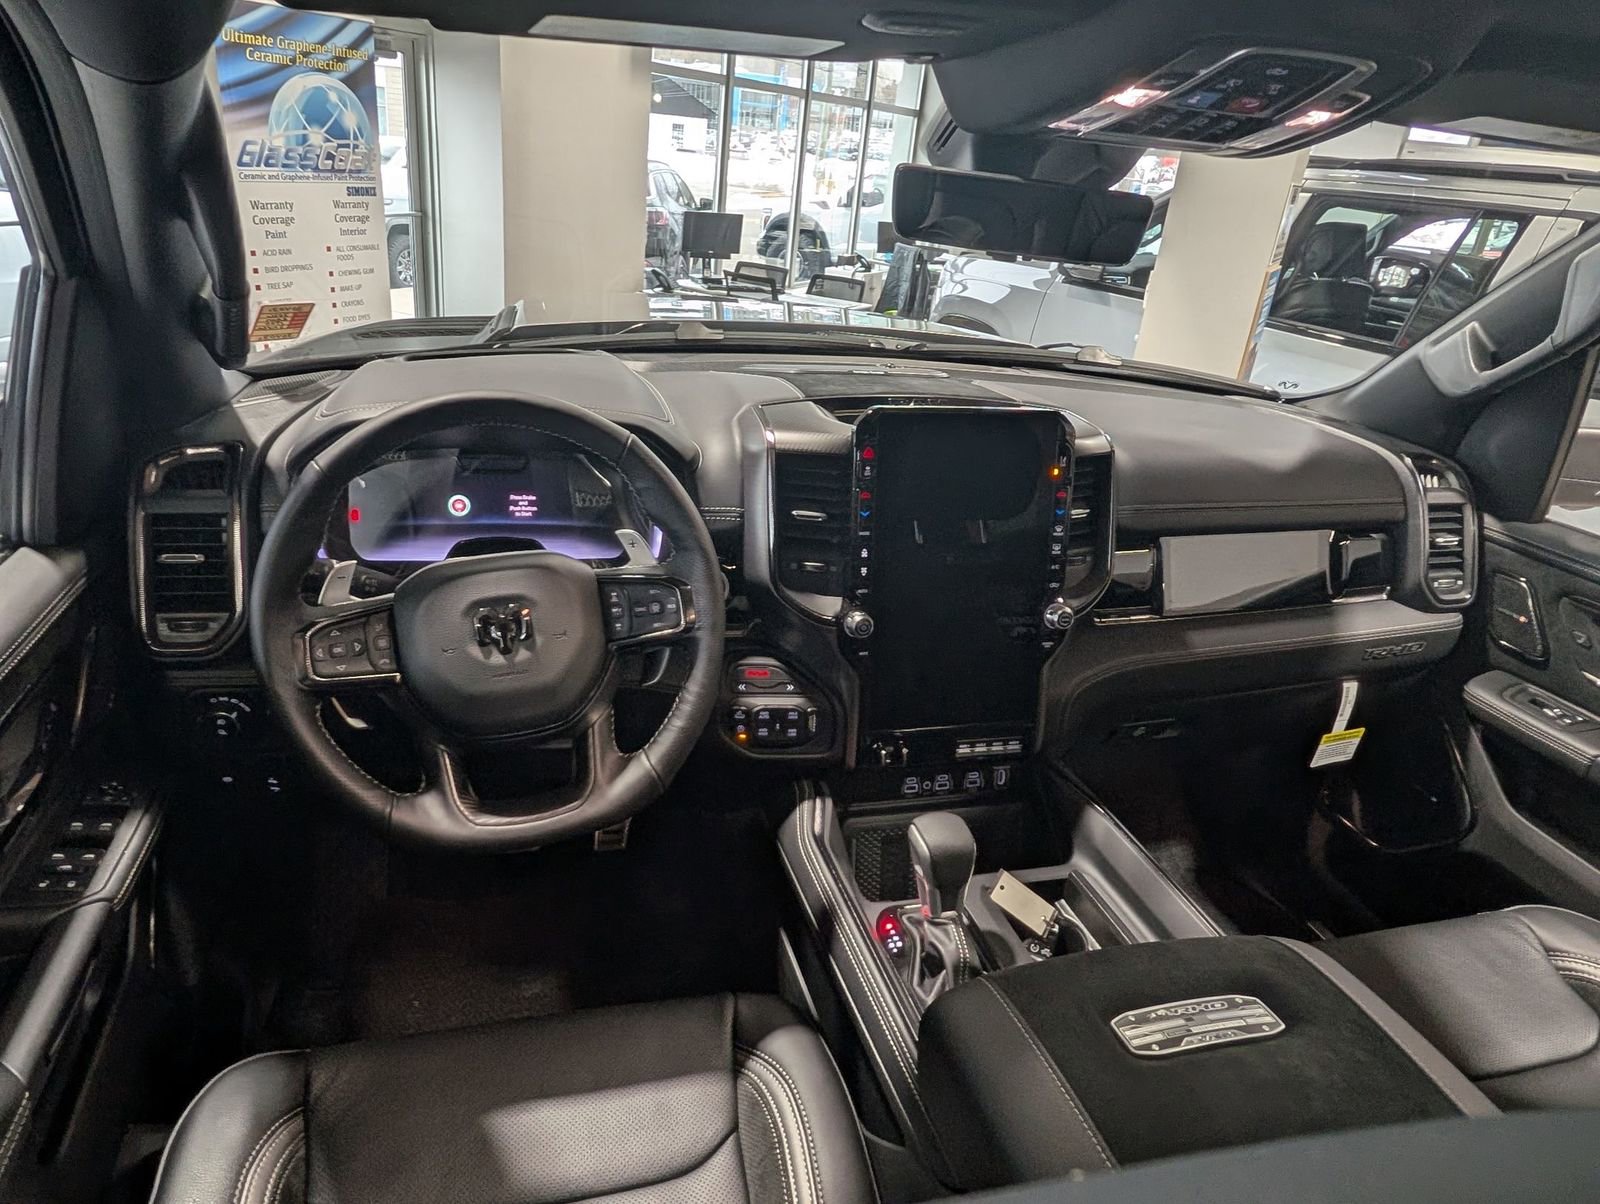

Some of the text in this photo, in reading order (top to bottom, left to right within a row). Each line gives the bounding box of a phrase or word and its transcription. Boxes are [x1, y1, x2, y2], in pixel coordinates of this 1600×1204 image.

[221, 28, 369, 61] Ultimate Graphene-Infused
[245, 47, 350, 73] Ceramic Protection
[238, 171, 267, 181] Ceramic
[267, 172, 280, 181] and
[333, 173, 348, 182] Paint
[348, 174, 377, 183] Protection
[249, 199, 294, 213] Warranty
[332, 199, 370, 211] Warranty
[252, 214, 296, 227] Coverage
[334, 213, 371, 225] Coverage
[264, 229, 288, 240] Paint
[339, 226, 368, 237] Interior
[262, 248, 293, 257] ACID RAIN
[336, 253, 355, 262] FOODS
[264, 263, 314, 274] BIRD DROPPINGS
[266, 280, 294, 290] TREE SAP
